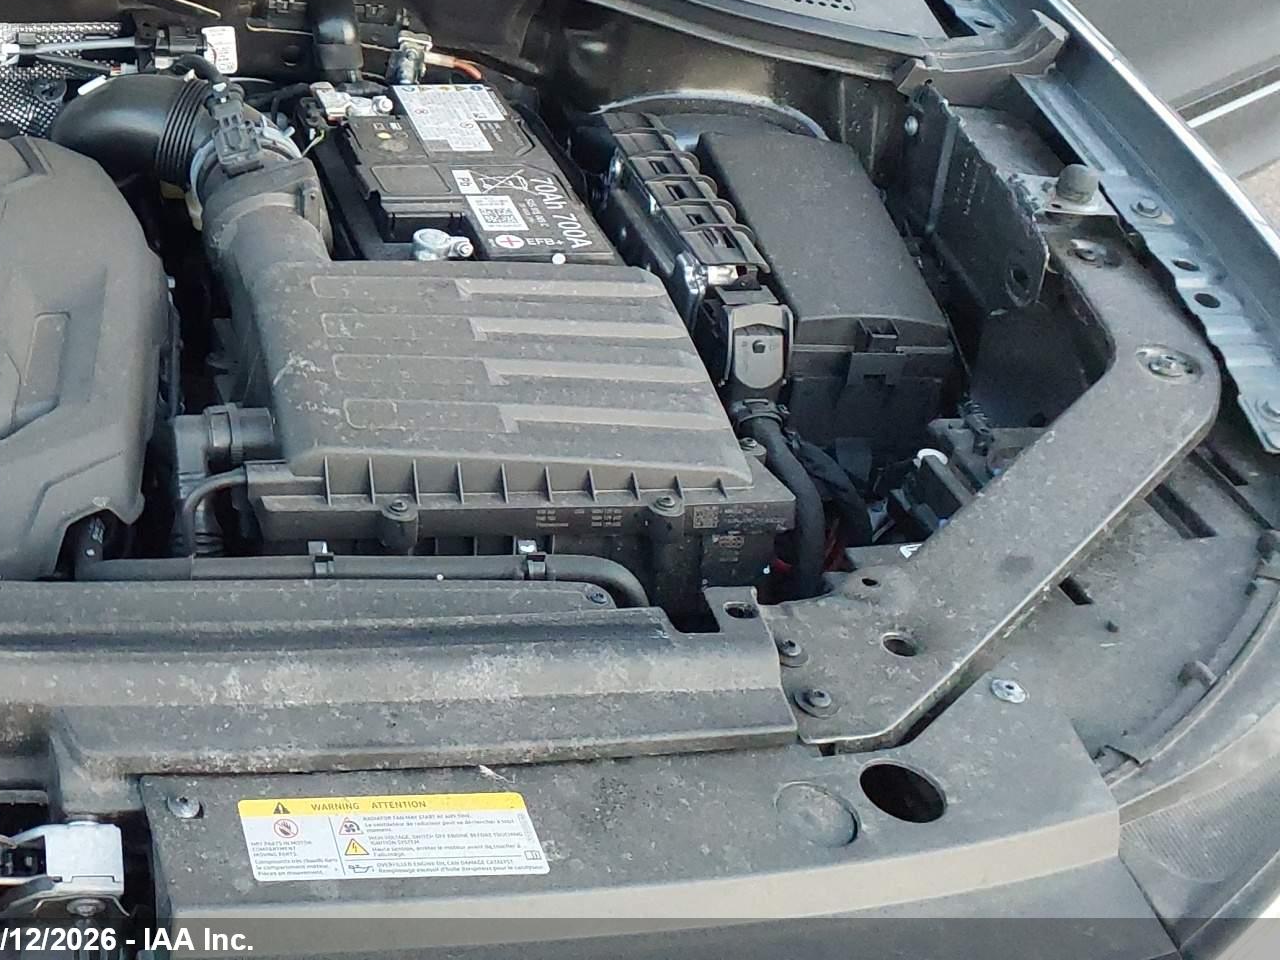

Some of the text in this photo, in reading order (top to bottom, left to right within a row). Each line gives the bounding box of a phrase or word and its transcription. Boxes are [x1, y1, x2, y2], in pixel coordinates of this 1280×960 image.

[530, 177, 568, 209] 70Ah
[552, 213, 593, 248] 700A
[525, 238, 565, 246] EFB+
[311, 800, 427, 811] WARNING ATTENTION
